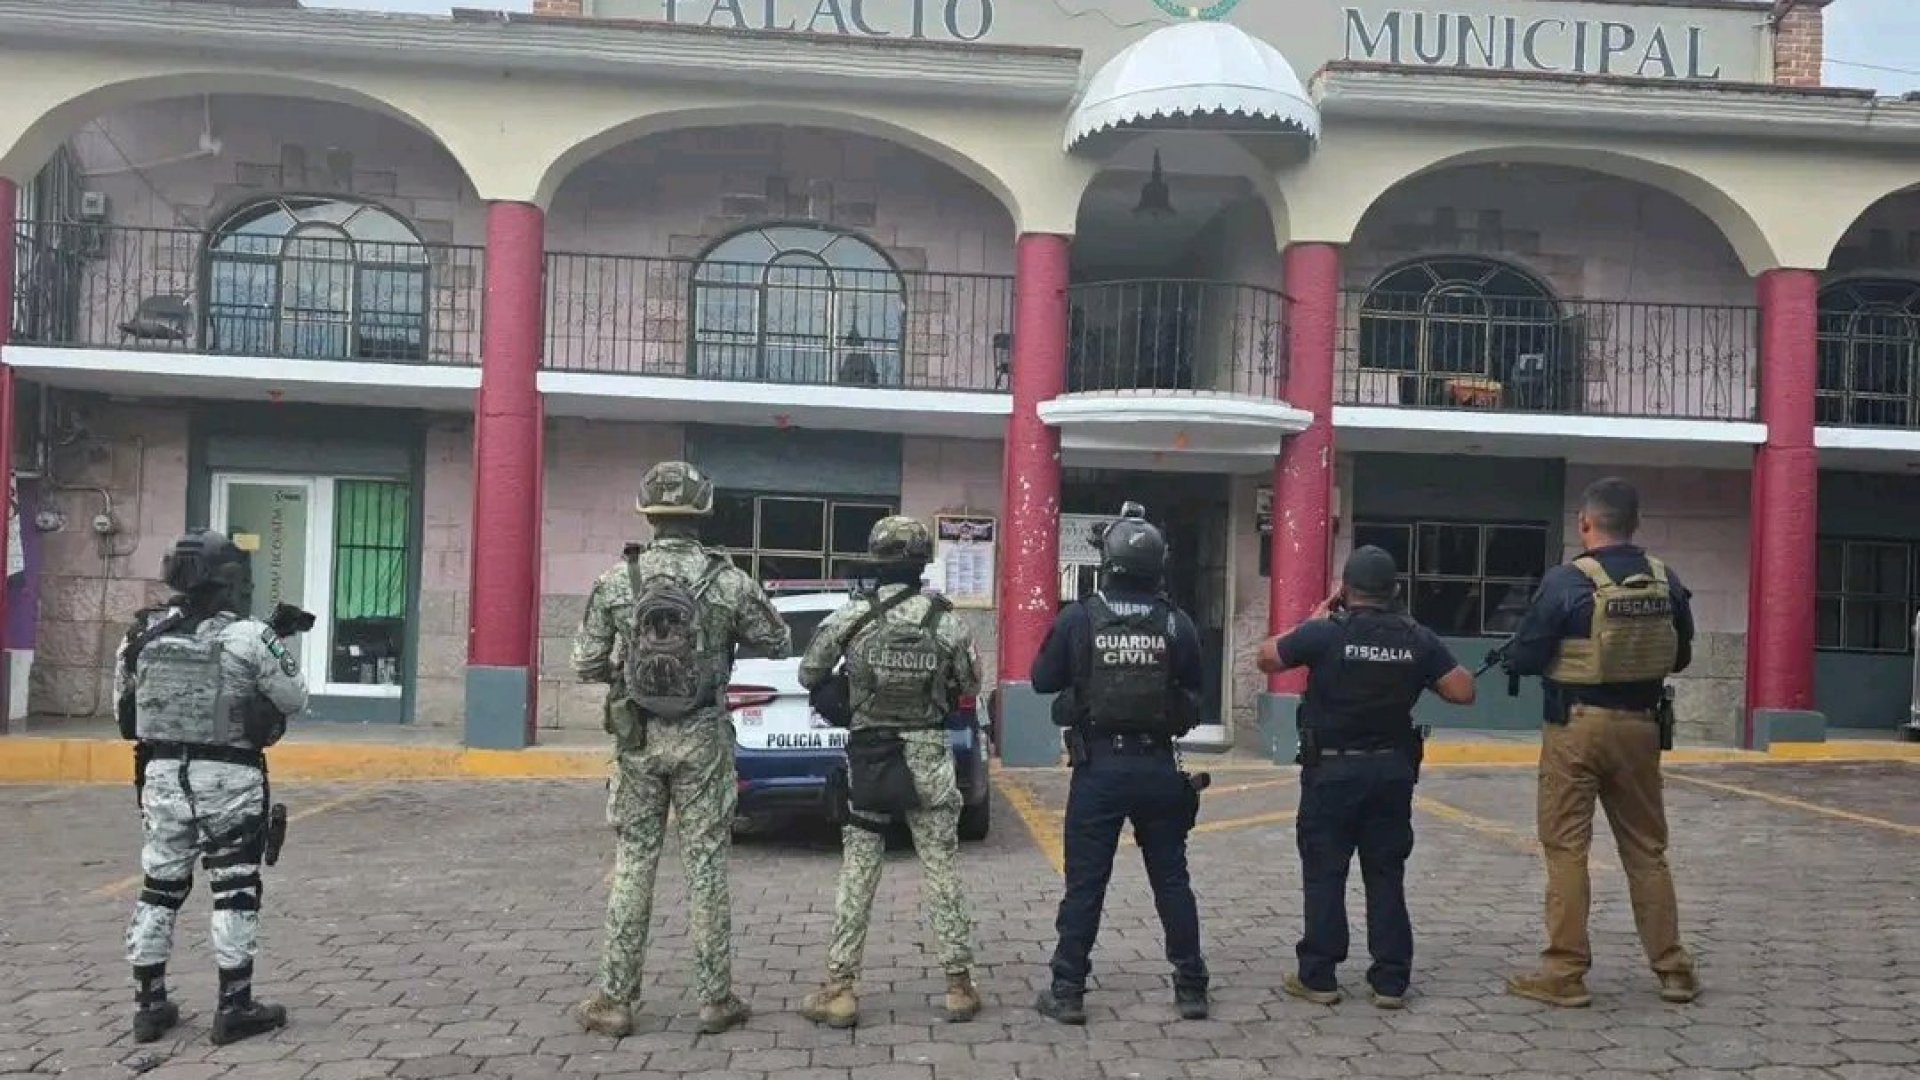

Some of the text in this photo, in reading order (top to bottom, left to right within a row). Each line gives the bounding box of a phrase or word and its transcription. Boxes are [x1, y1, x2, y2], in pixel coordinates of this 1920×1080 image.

[1344, 8, 1720, 79] MUNICIPAL
[1095, 634, 1166, 650] GUARDIA
[1103, 649, 1160, 665] CIVIL
[1344, 644, 1413, 661] FISCALIA
